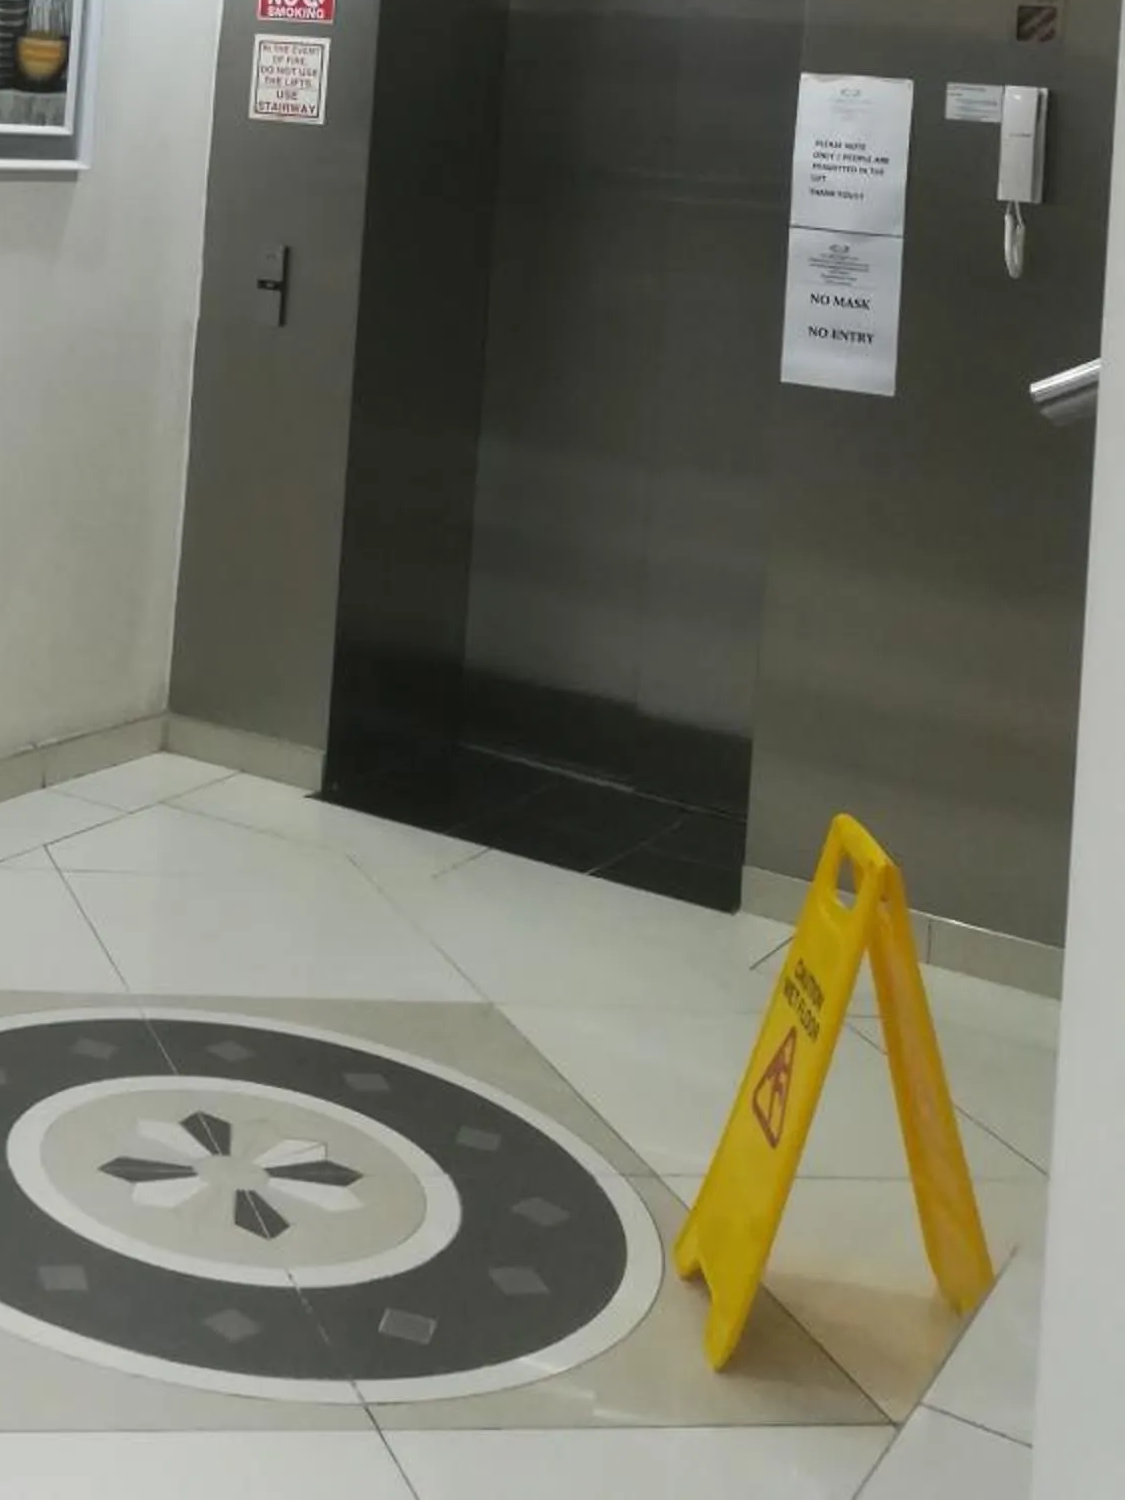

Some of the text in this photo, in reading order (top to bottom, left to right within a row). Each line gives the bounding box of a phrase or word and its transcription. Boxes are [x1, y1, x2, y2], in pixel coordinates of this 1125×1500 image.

[267, 5, 325, 19] SMOKING
[261, 65, 317, 77] DO NOT USE
[276, 89, 298, 101] USE
[259, 101, 315, 113] STAIRWAY
[810, 292, 870, 311] NO MASK
[807, 325, 874, 345] NO ENTRY
